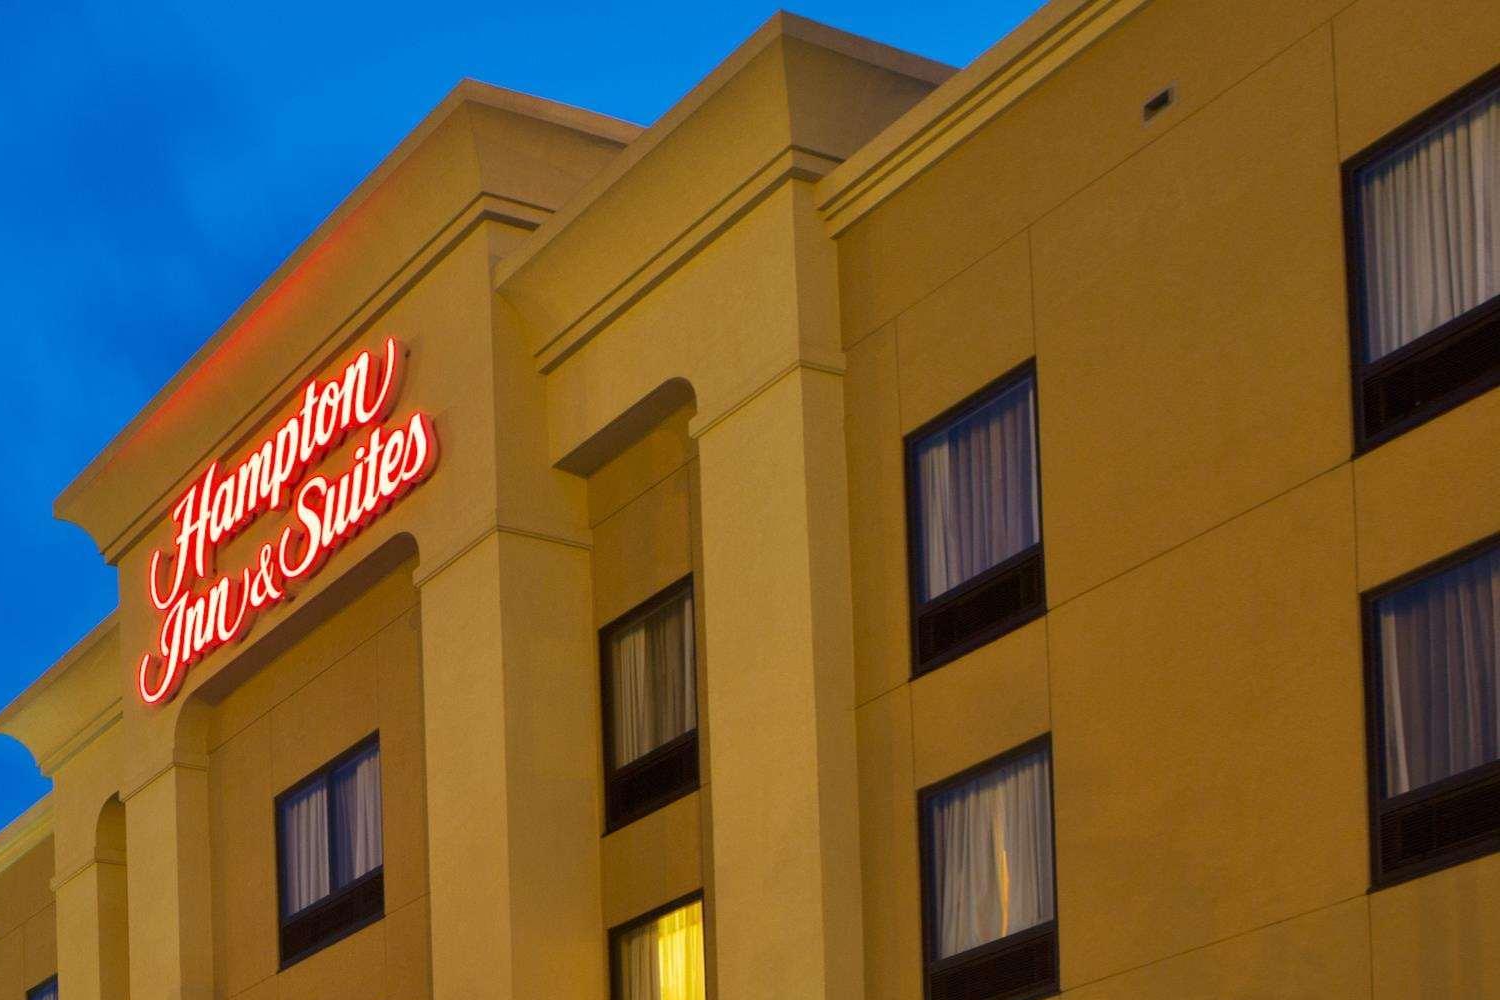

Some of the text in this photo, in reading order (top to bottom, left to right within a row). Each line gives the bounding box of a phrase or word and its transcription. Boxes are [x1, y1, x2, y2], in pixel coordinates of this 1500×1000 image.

[139, 412, 428, 703] Inn & Suites
[150, 337, 396, 610] Hampton
